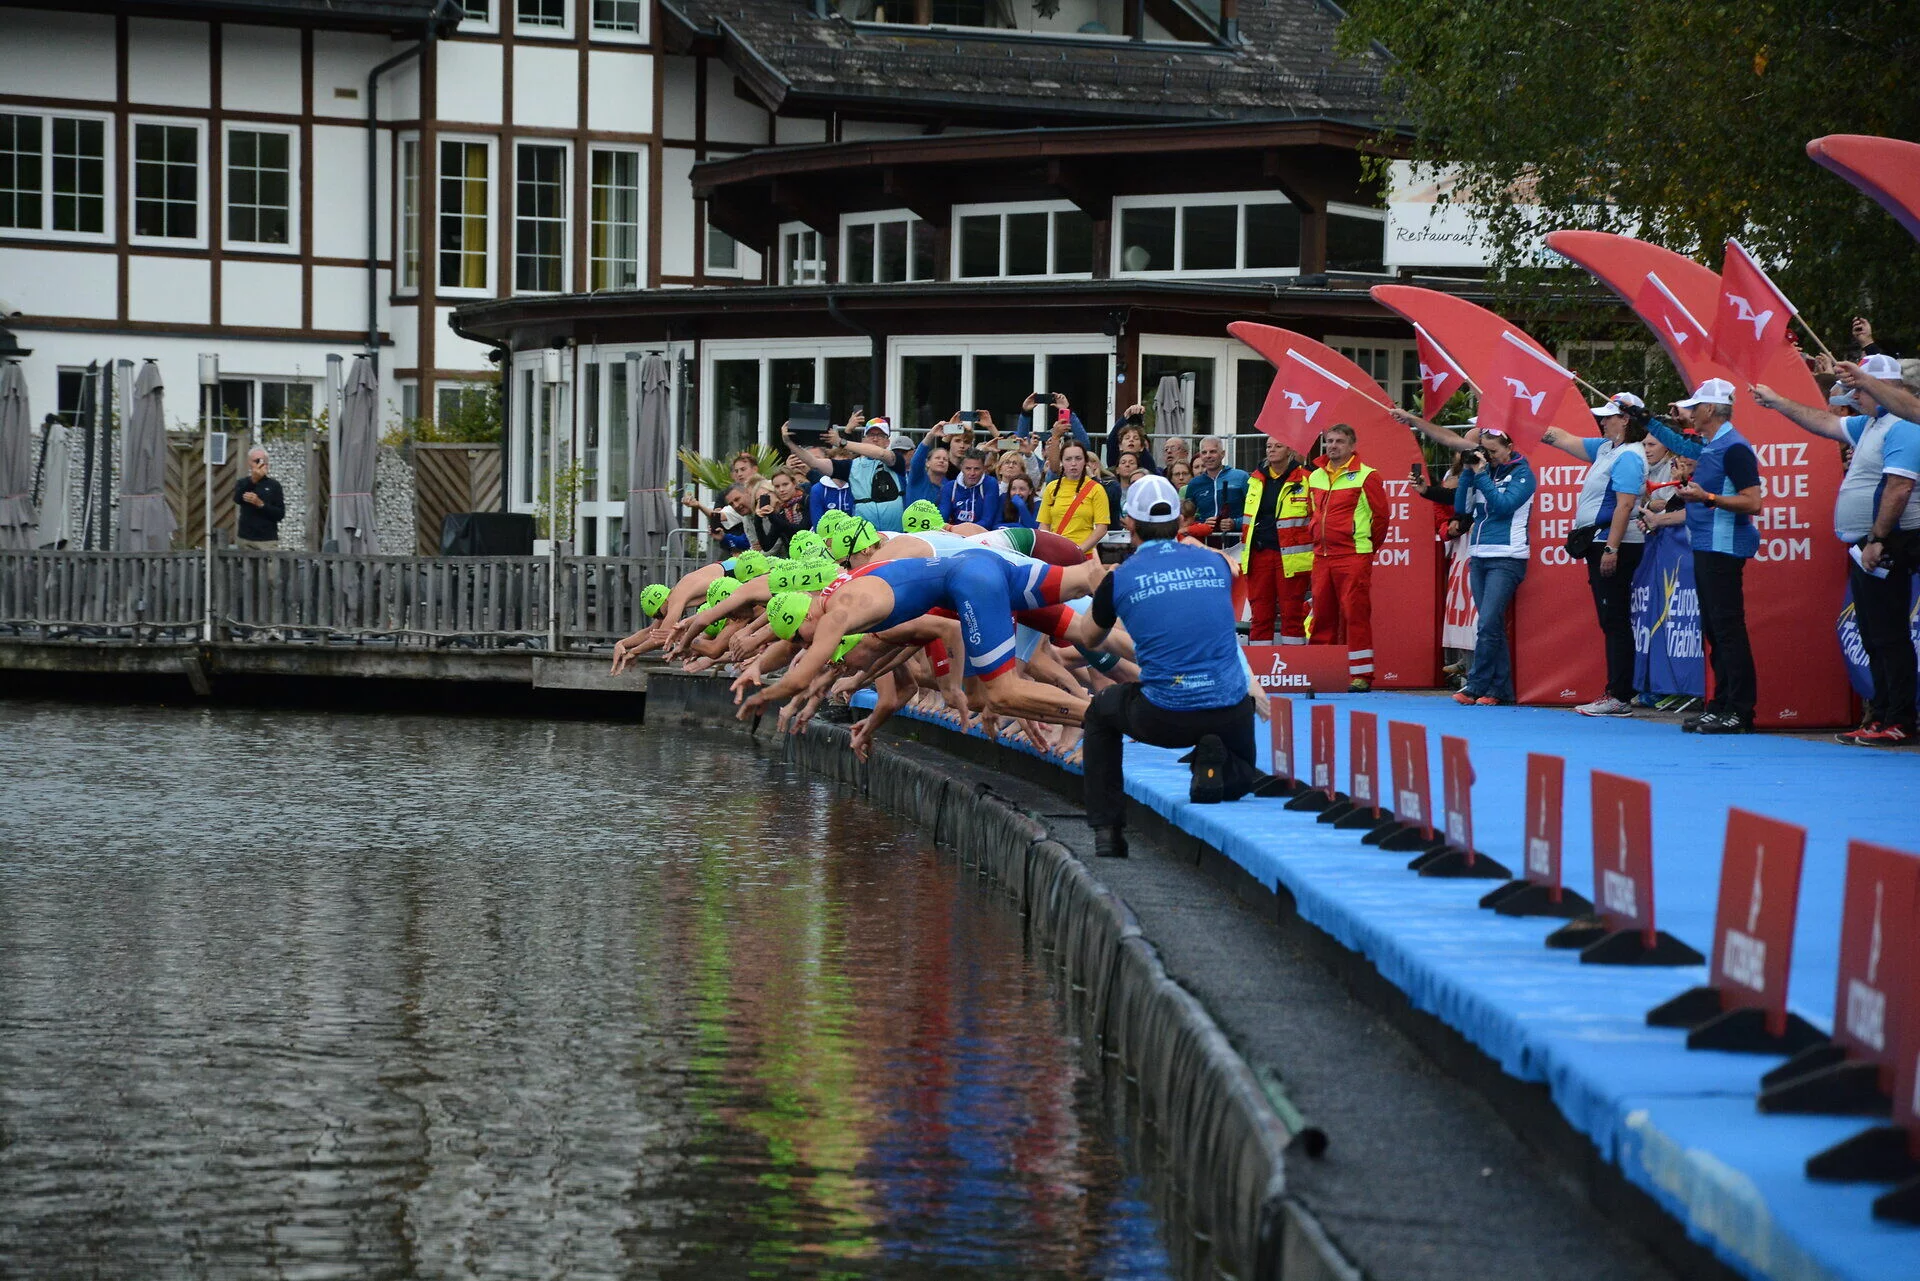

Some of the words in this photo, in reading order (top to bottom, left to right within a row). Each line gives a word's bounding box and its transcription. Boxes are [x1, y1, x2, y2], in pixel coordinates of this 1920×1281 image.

[1396, 226, 1478, 242] Restaurant
[1752, 443, 1808, 466] KITZ
[1540, 466, 1588, 485] KITZ
[1382, 480, 1410, 496] ITZ
[1540, 493, 1580, 512] BU
[907, 516, 930, 530] 28
[1753, 507, 1810, 530] HEL.
[1384, 527, 1410, 542] EL.
[1540, 520, 1576, 539] HE
[843, 535, 853, 547] 9
[1754, 538, 1811, 561] COM
[746, 564, 754, 575] 2
[1135, 566, 1217, 589] Triathlon
[801, 572, 823, 586] 21
[648, 591, 662, 606] 15
[1129, 585, 1166, 604] HEAD
[1169, 578, 1226, 591] REFEREE
[782, 612, 794, 625] 5
[1254, 674, 1311, 687] BÜHEL
